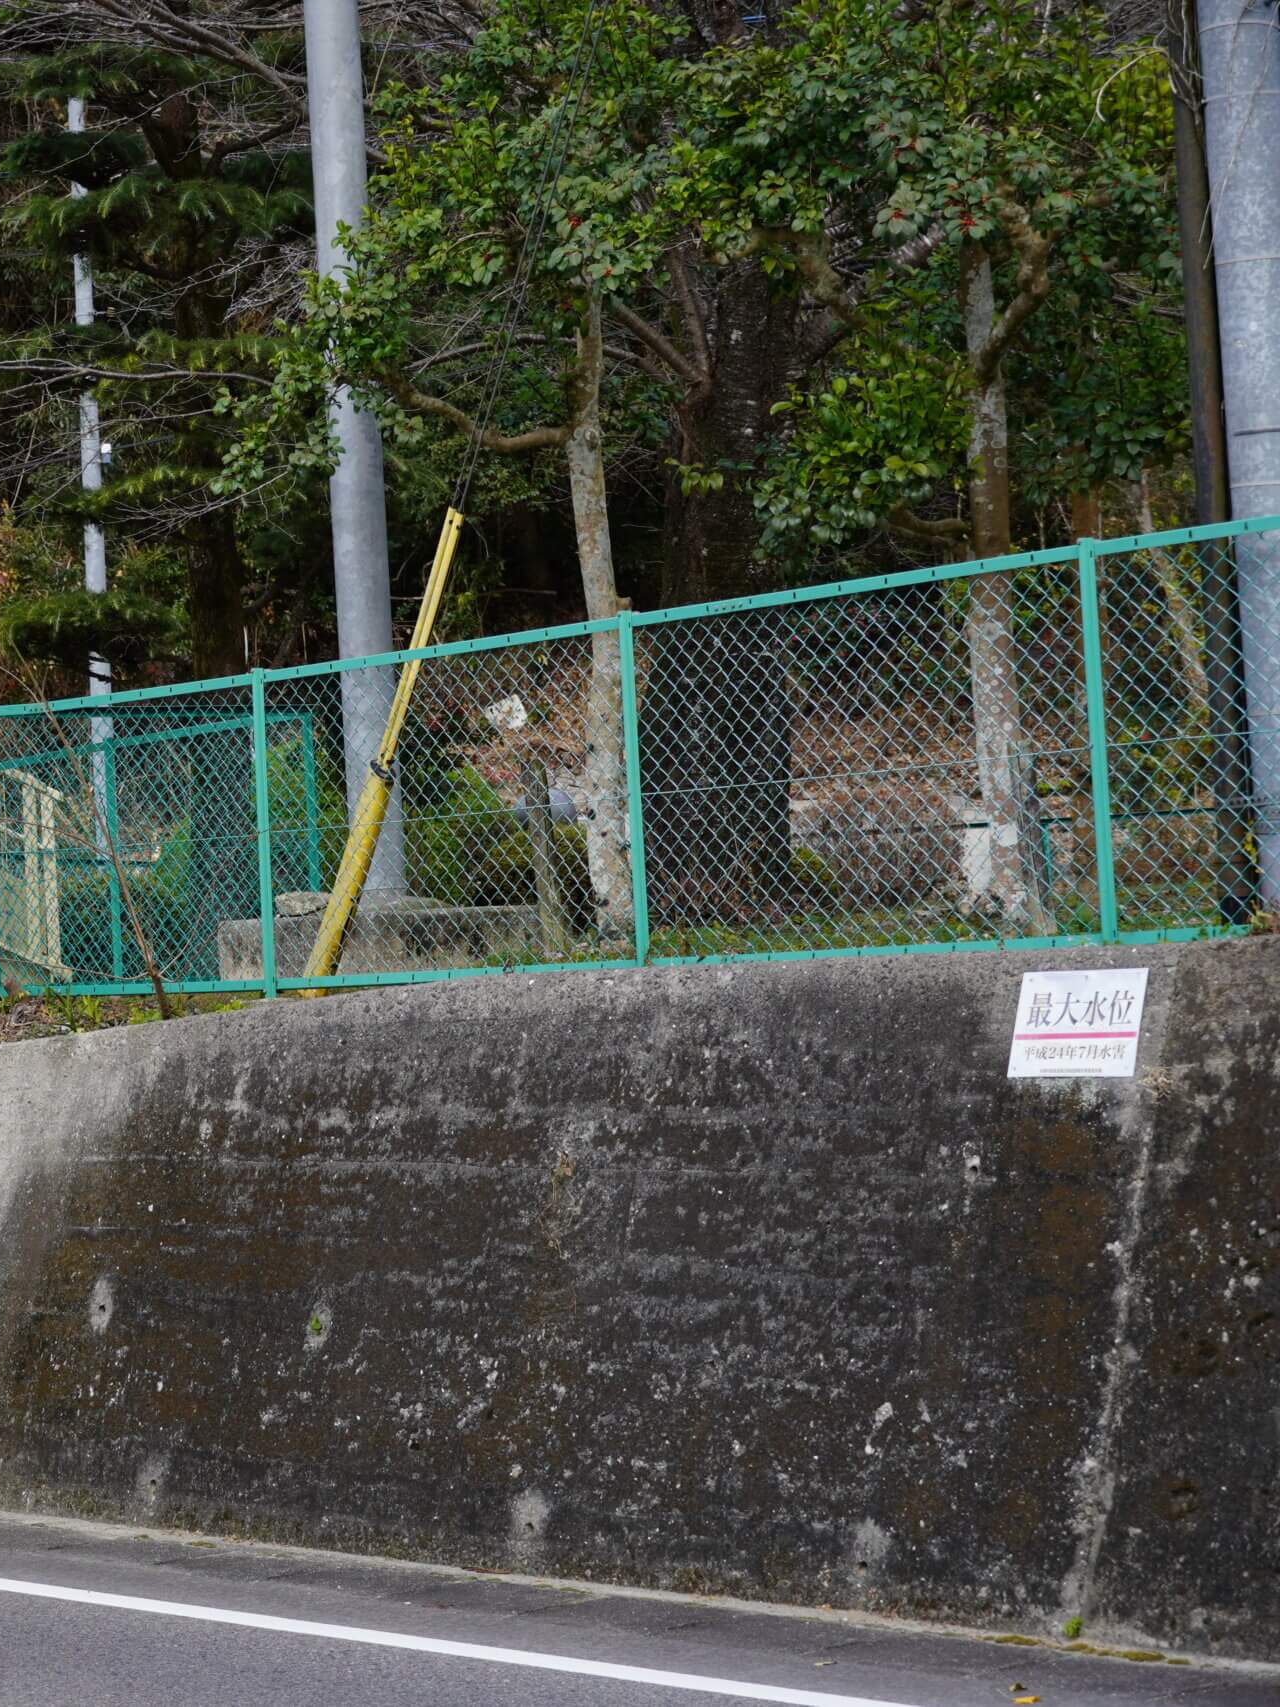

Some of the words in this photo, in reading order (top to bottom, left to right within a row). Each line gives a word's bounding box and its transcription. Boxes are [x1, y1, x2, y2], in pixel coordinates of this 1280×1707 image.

[1026, 990, 1135, 1028] 最大水位
[1024, 1044, 1126, 1061] 平成24年7月水害
